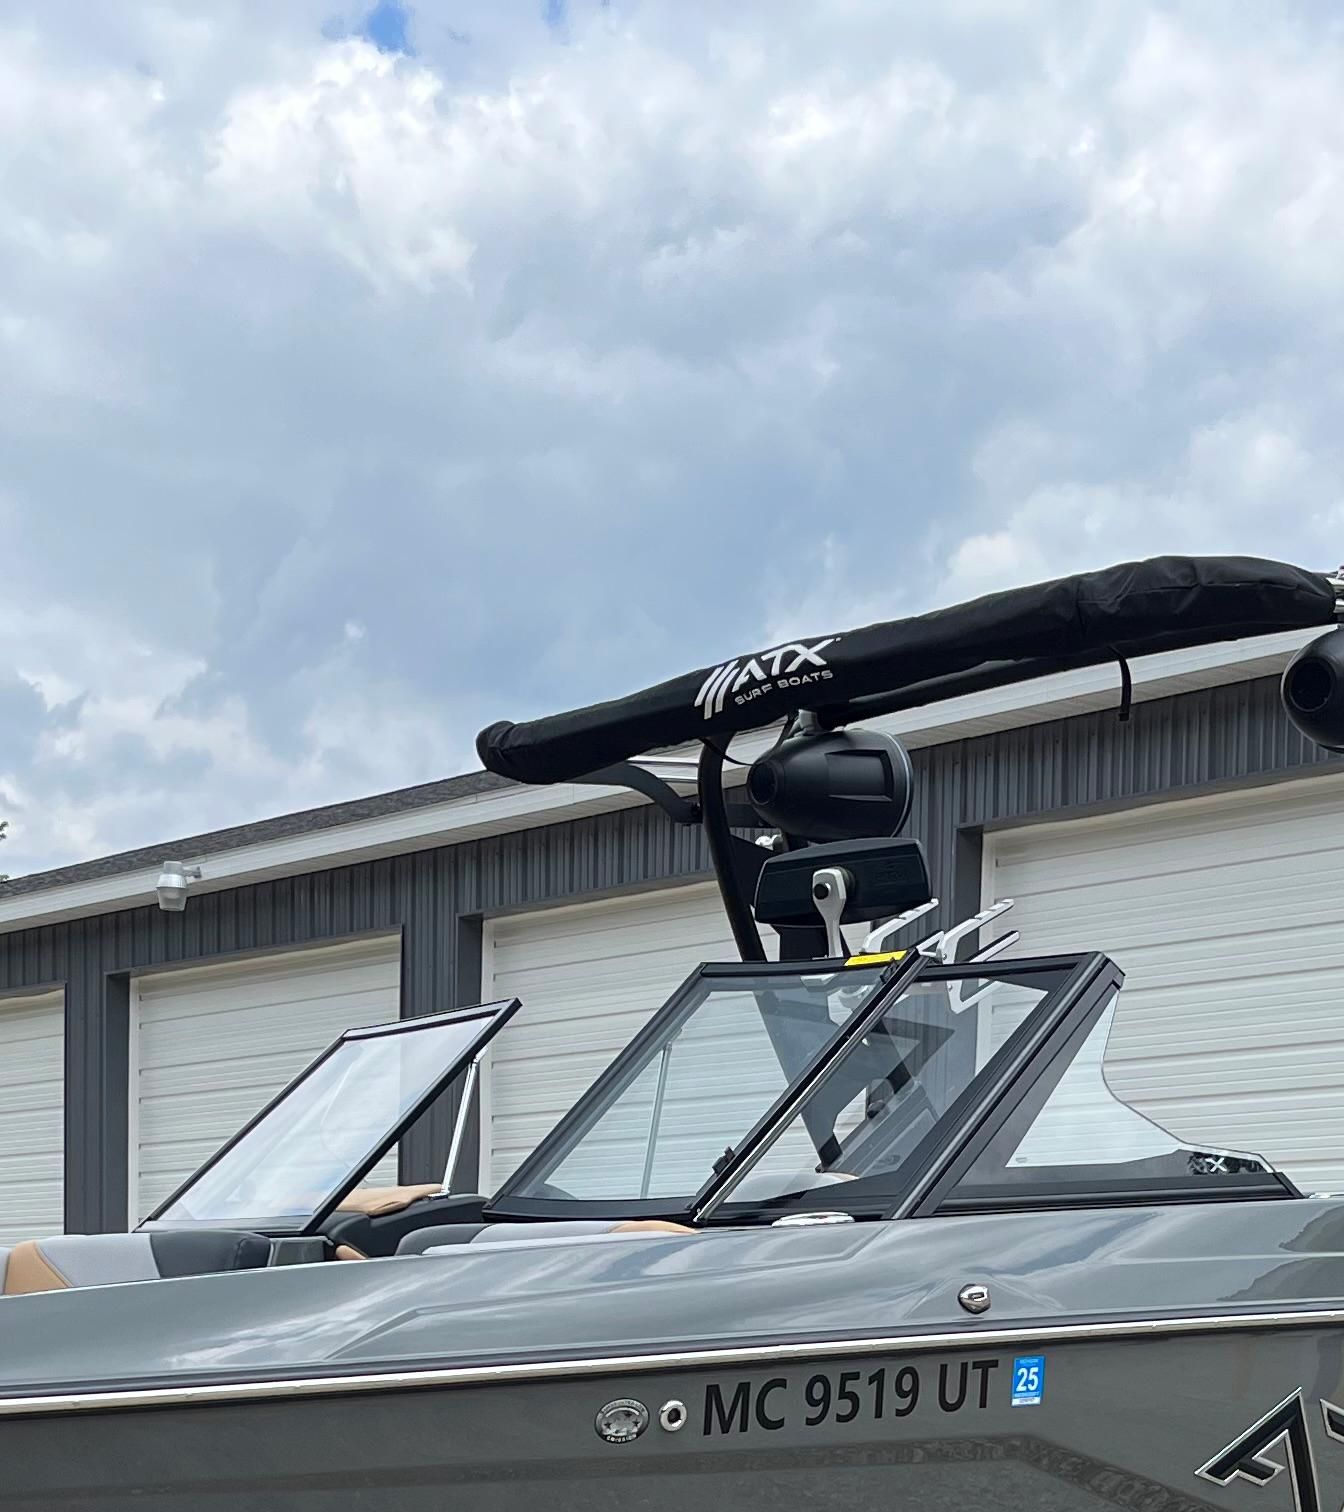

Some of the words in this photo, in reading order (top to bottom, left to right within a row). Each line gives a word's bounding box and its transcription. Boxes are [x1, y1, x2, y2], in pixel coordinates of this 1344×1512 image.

[732, 638, 835, 692] ATX
[735, 683, 773, 705] SURF
[777, 669, 834, 689] BOATS
[703, 1377, 788, 1437] MC
[805, 1365, 920, 1427] 9519
[938, 1359, 999, 1413] UT
[1016, 1366, 1039, 1392] 25
